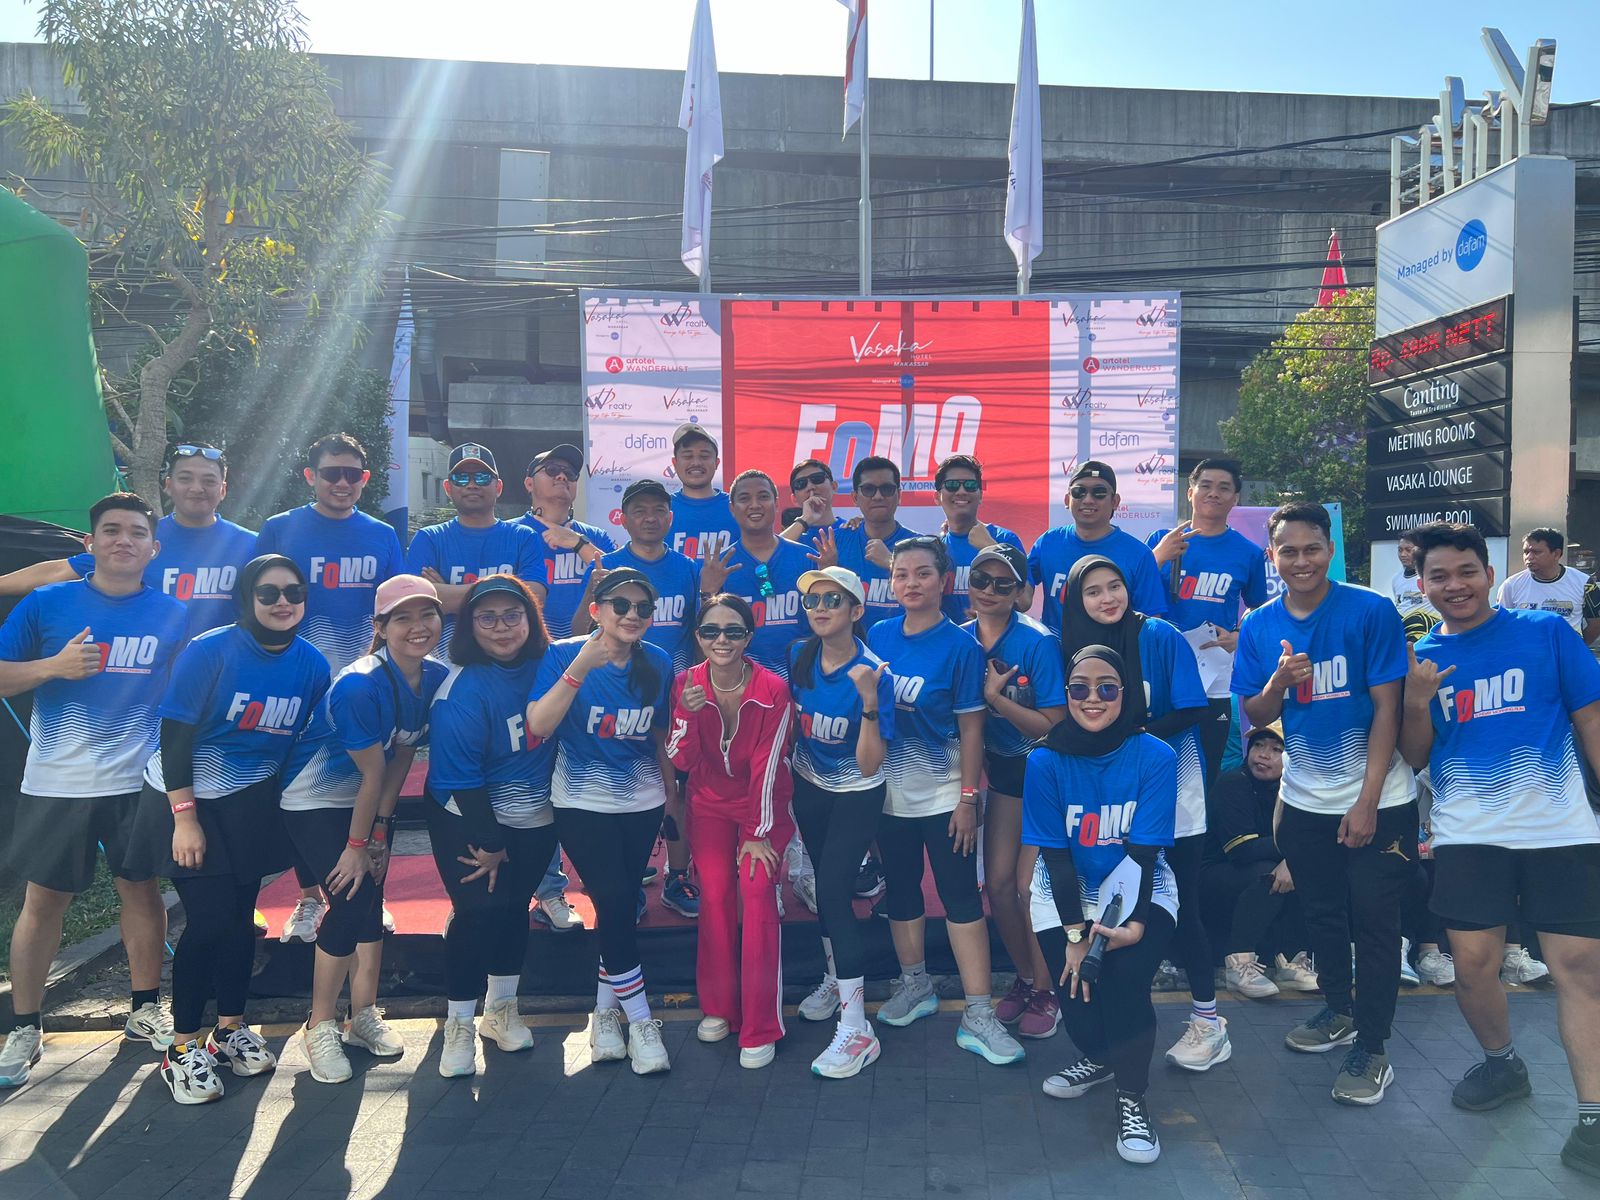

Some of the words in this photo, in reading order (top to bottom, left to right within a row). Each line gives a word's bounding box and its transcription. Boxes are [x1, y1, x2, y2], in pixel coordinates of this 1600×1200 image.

[1457, 234, 1485, 257] dafam
[1397, 251, 1439, 280] Managed
[1442, 247, 1453, 263] by
[583, 302, 630, 325] Vasaka
[685, 320, 708, 328] realty
[1062, 304, 1107, 328] Vasaka
[850, 321, 935, 363] Vasaka
[626, 356, 655, 364] artotel
[608, 402, 632, 411] realty
[664, 387, 709, 410] Vasaka
[1084, 400, 1107, 409] realty
[1403, 381, 1459, 409] Canting
[625, 433, 667, 452] dafam
[1099, 431, 1140, 449] dafam
[1388, 429, 1432, 452] MEETING
[1435, 421, 1475, 445] ROOMS
[586, 455, 632, 479] Vasaka
[1386, 472, 1426, 491] VASAKA
[1429, 466, 1473, 488] LOUNGE
[908, 482, 936, 490] MORN
[1386, 511, 1441, 531] SWIMMING
[1445, 509, 1475, 527] POOL
